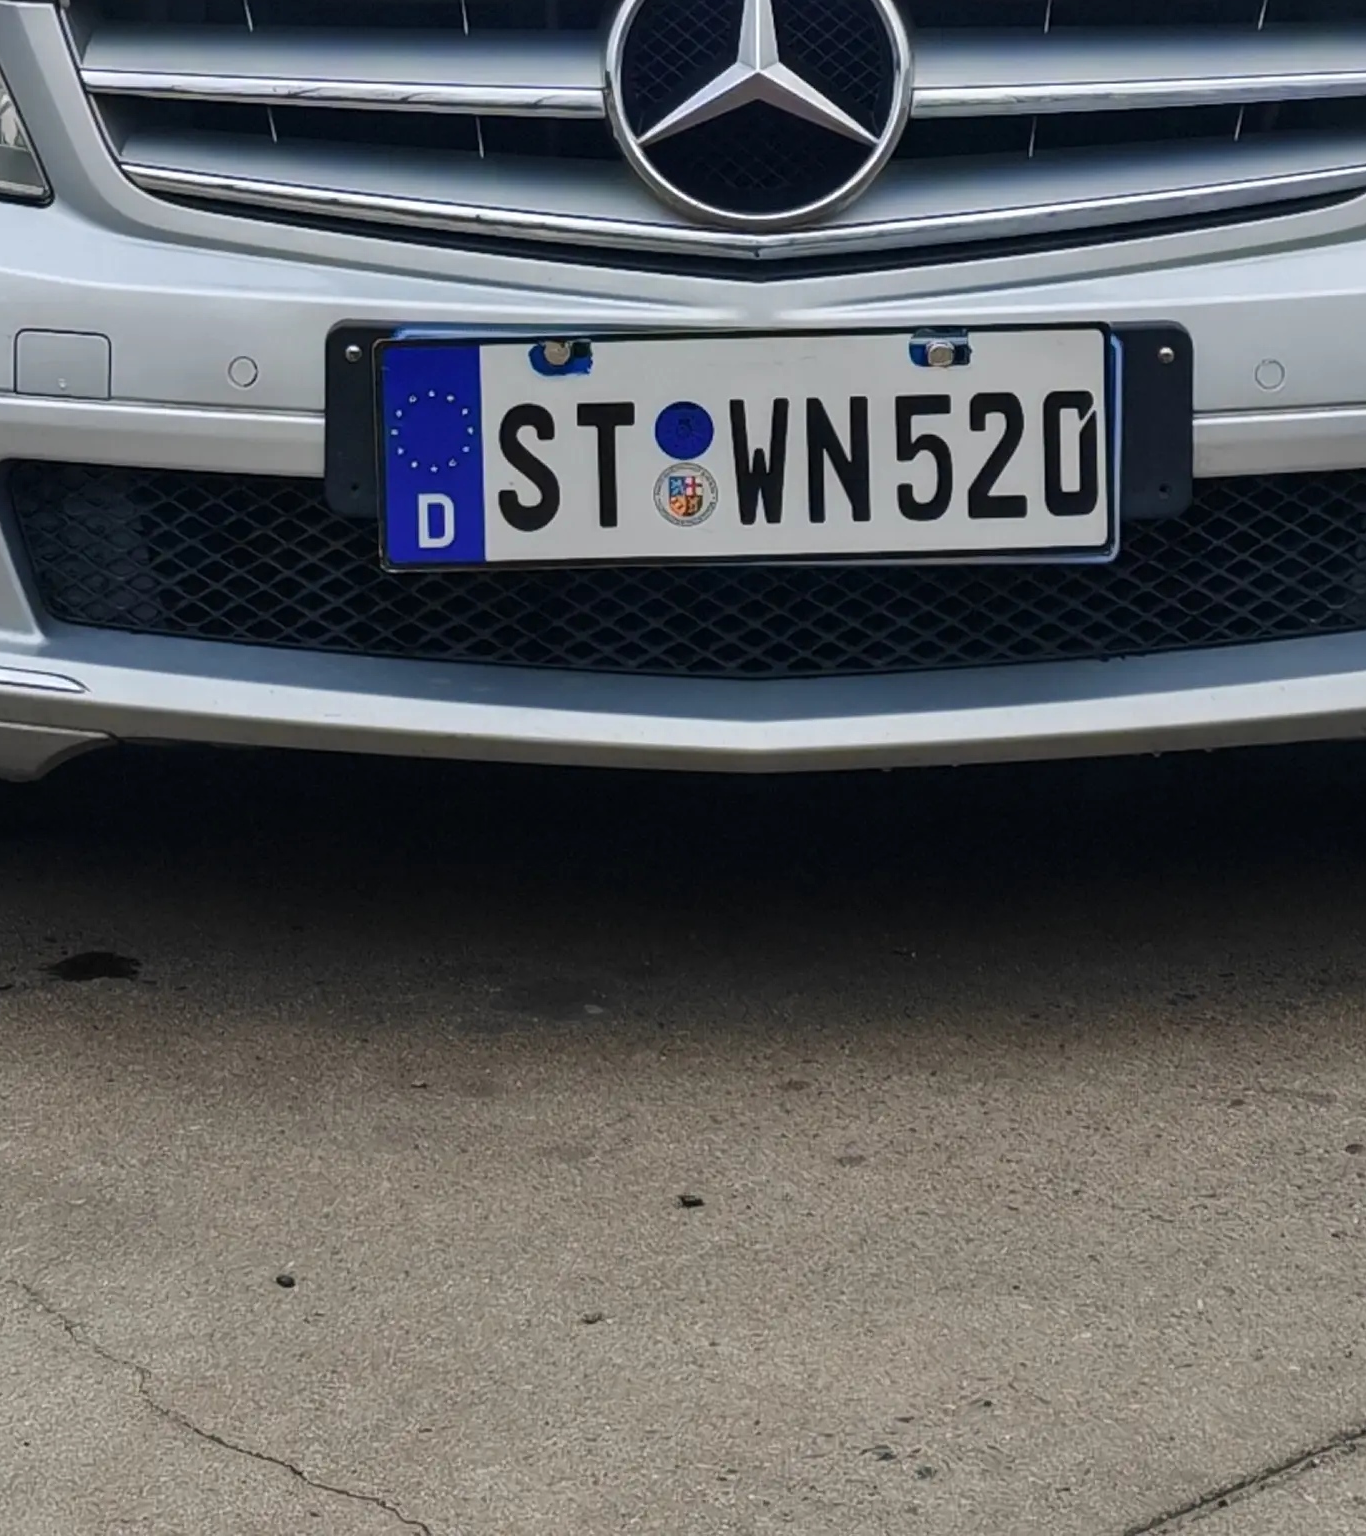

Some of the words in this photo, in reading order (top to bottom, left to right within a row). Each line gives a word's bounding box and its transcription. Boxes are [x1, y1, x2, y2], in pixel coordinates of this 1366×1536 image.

[497, 401, 636, 532] ST
[728, 389, 1099, 526] WN520
[418, 492, 456, 549] D
